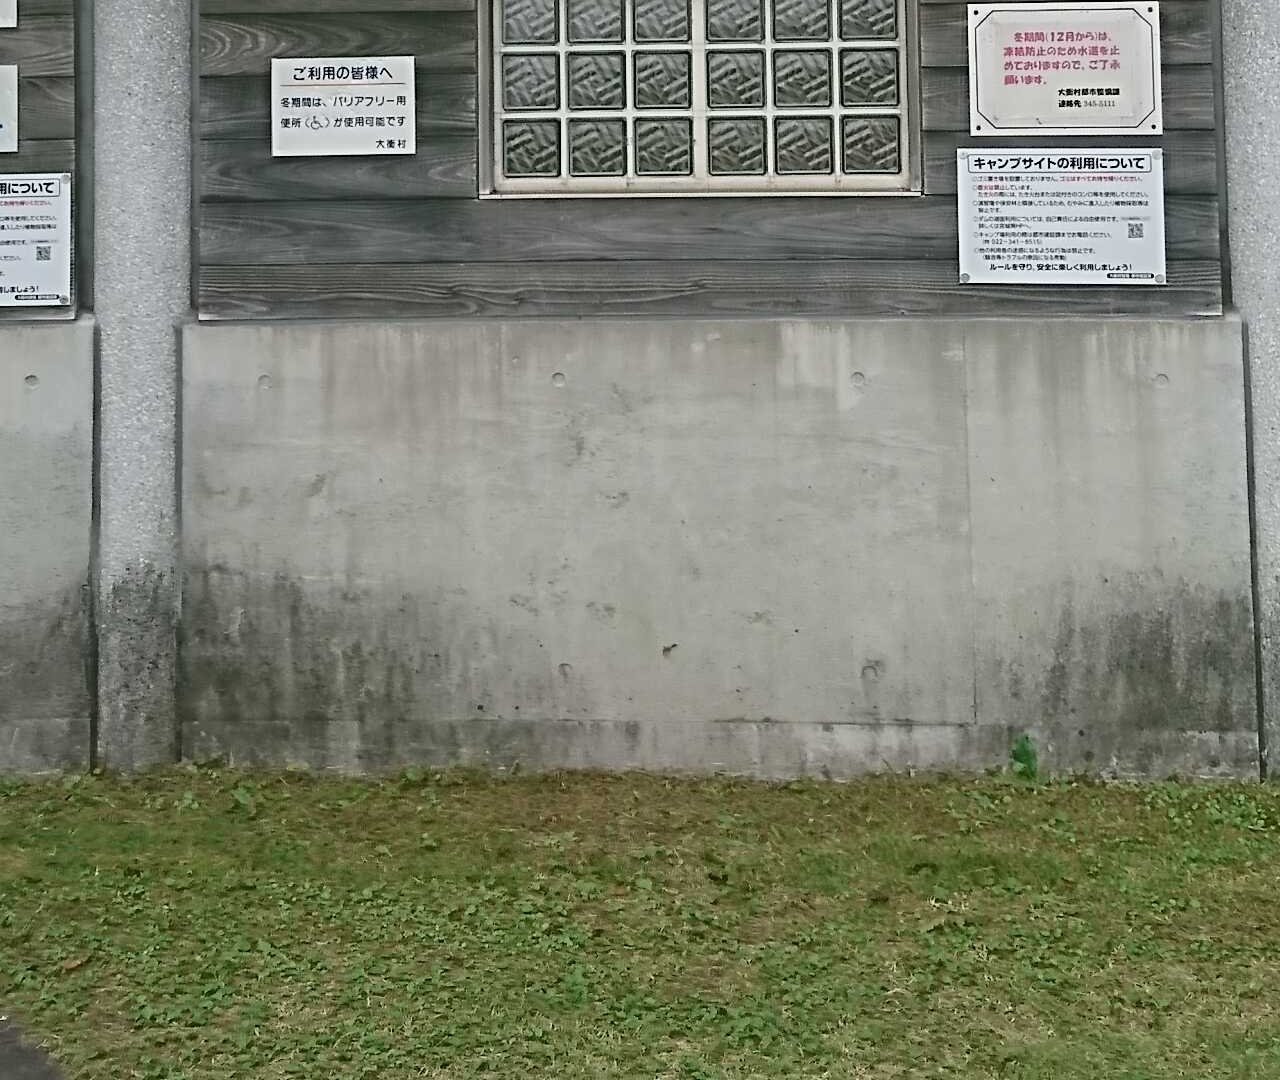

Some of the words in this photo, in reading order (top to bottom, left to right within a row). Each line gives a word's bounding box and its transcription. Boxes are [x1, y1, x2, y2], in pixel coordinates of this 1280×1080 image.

[293, 66, 393, 81] ご利用の皆様へ
[1058, 100, 1082, 108] 連絡先
[376, 139, 407, 149] 大衡村
[973, 157, 1146, 170] キャンプサイトの利用について
